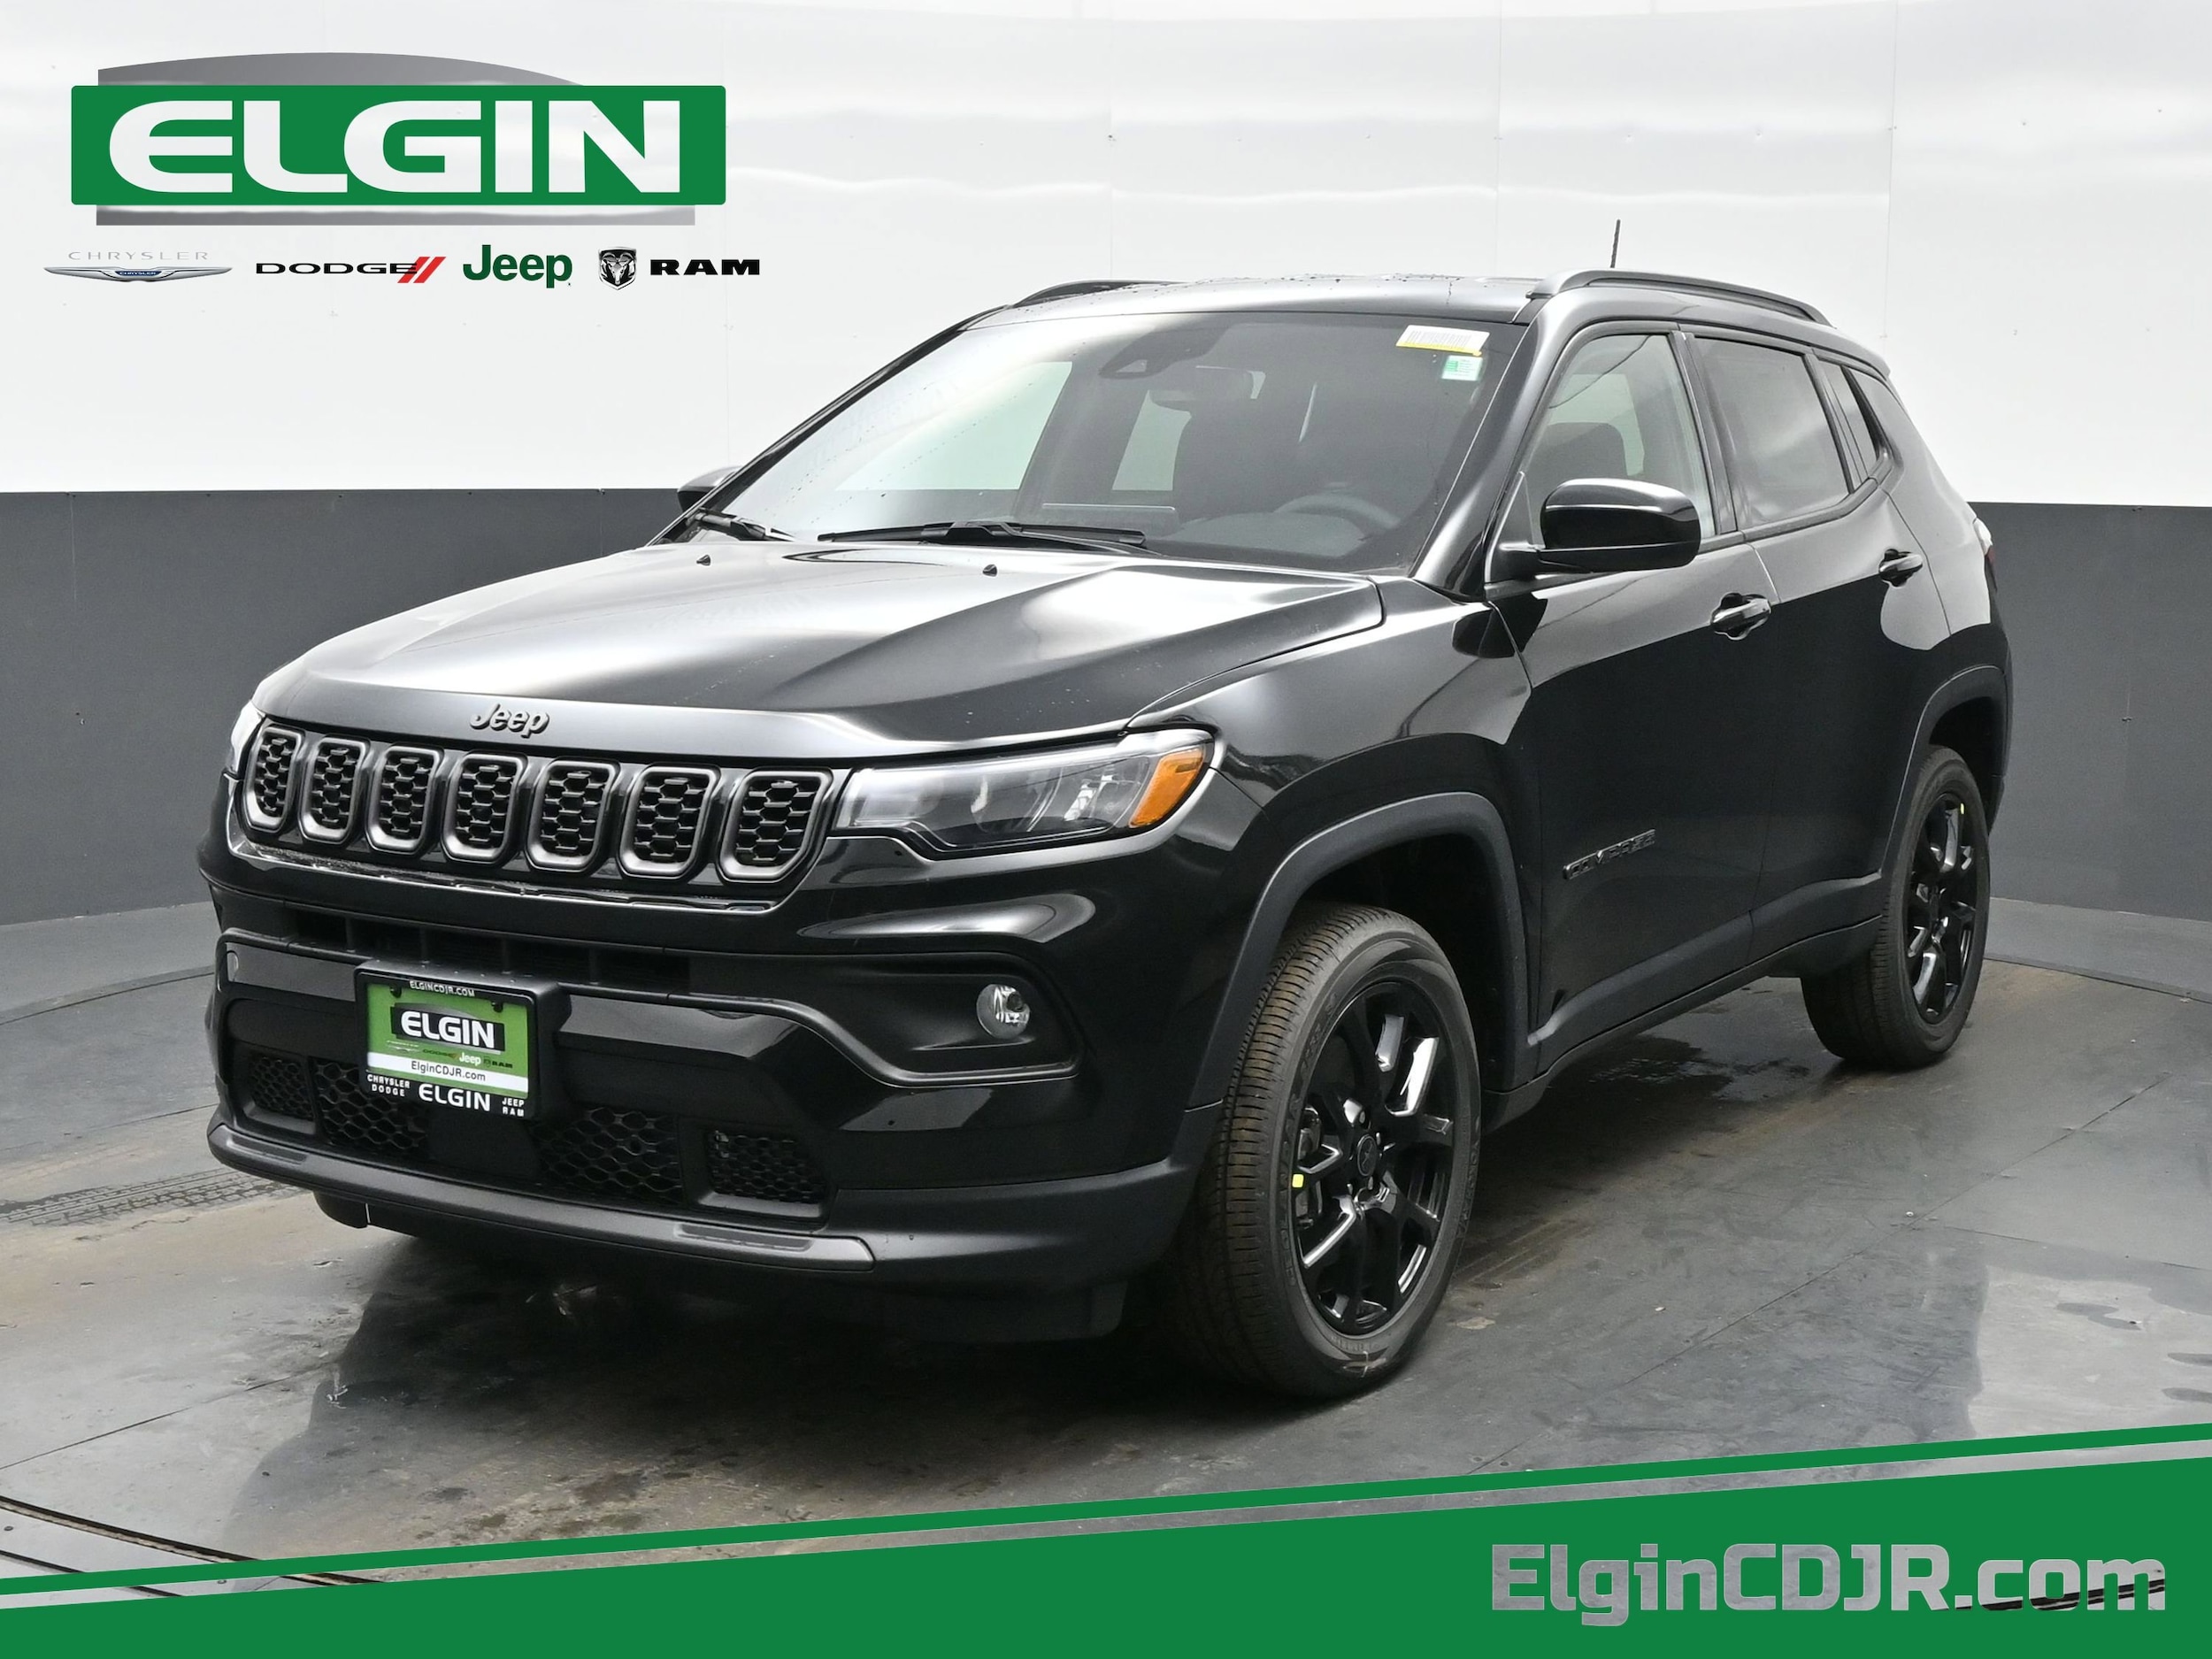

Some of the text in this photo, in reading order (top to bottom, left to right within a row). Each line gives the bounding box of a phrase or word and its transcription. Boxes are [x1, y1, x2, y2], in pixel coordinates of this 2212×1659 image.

[469, 703, 550, 739] Jeep
[409, 979, 475, 997] ELGINCDJR.COM
[401, 1010, 495, 1048] ELGIN
[458, 1051, 482, 1067] Jeep
[411, 1060, 486, 1081] ElginCDJR.com
[367, 1073, 410, 1089] CHRYSLER
[372, 1084, 405, 1097] DODGE
[419, 1083, 491, 1112] ELGIN
[502, 1097, 525, 1108] JEEP
[503, 1107, 525, 1118] RAM
